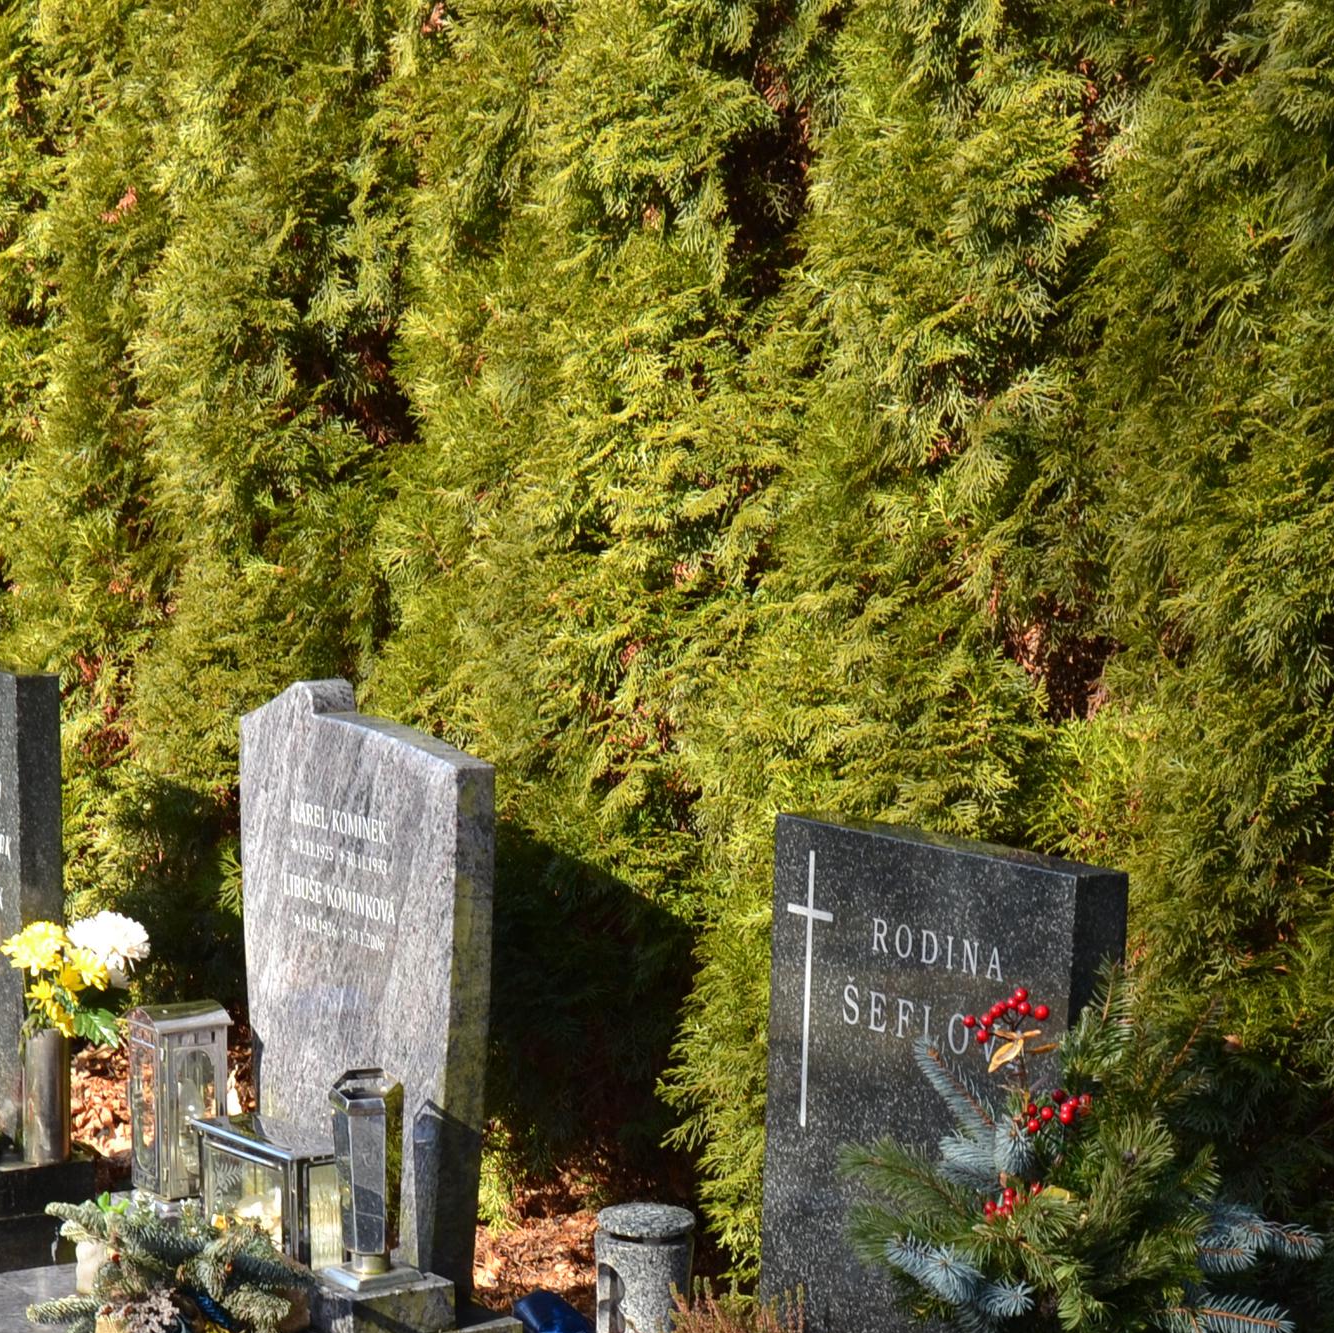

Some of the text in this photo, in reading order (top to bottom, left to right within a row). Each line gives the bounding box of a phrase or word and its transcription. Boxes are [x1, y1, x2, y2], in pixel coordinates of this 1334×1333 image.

[290, 799, 328, 830] KAREL
[283, 872, 396, 925] LIBUŠE KOMÍNKOVÁ
[871, 916, 1004, 983] RODINA
